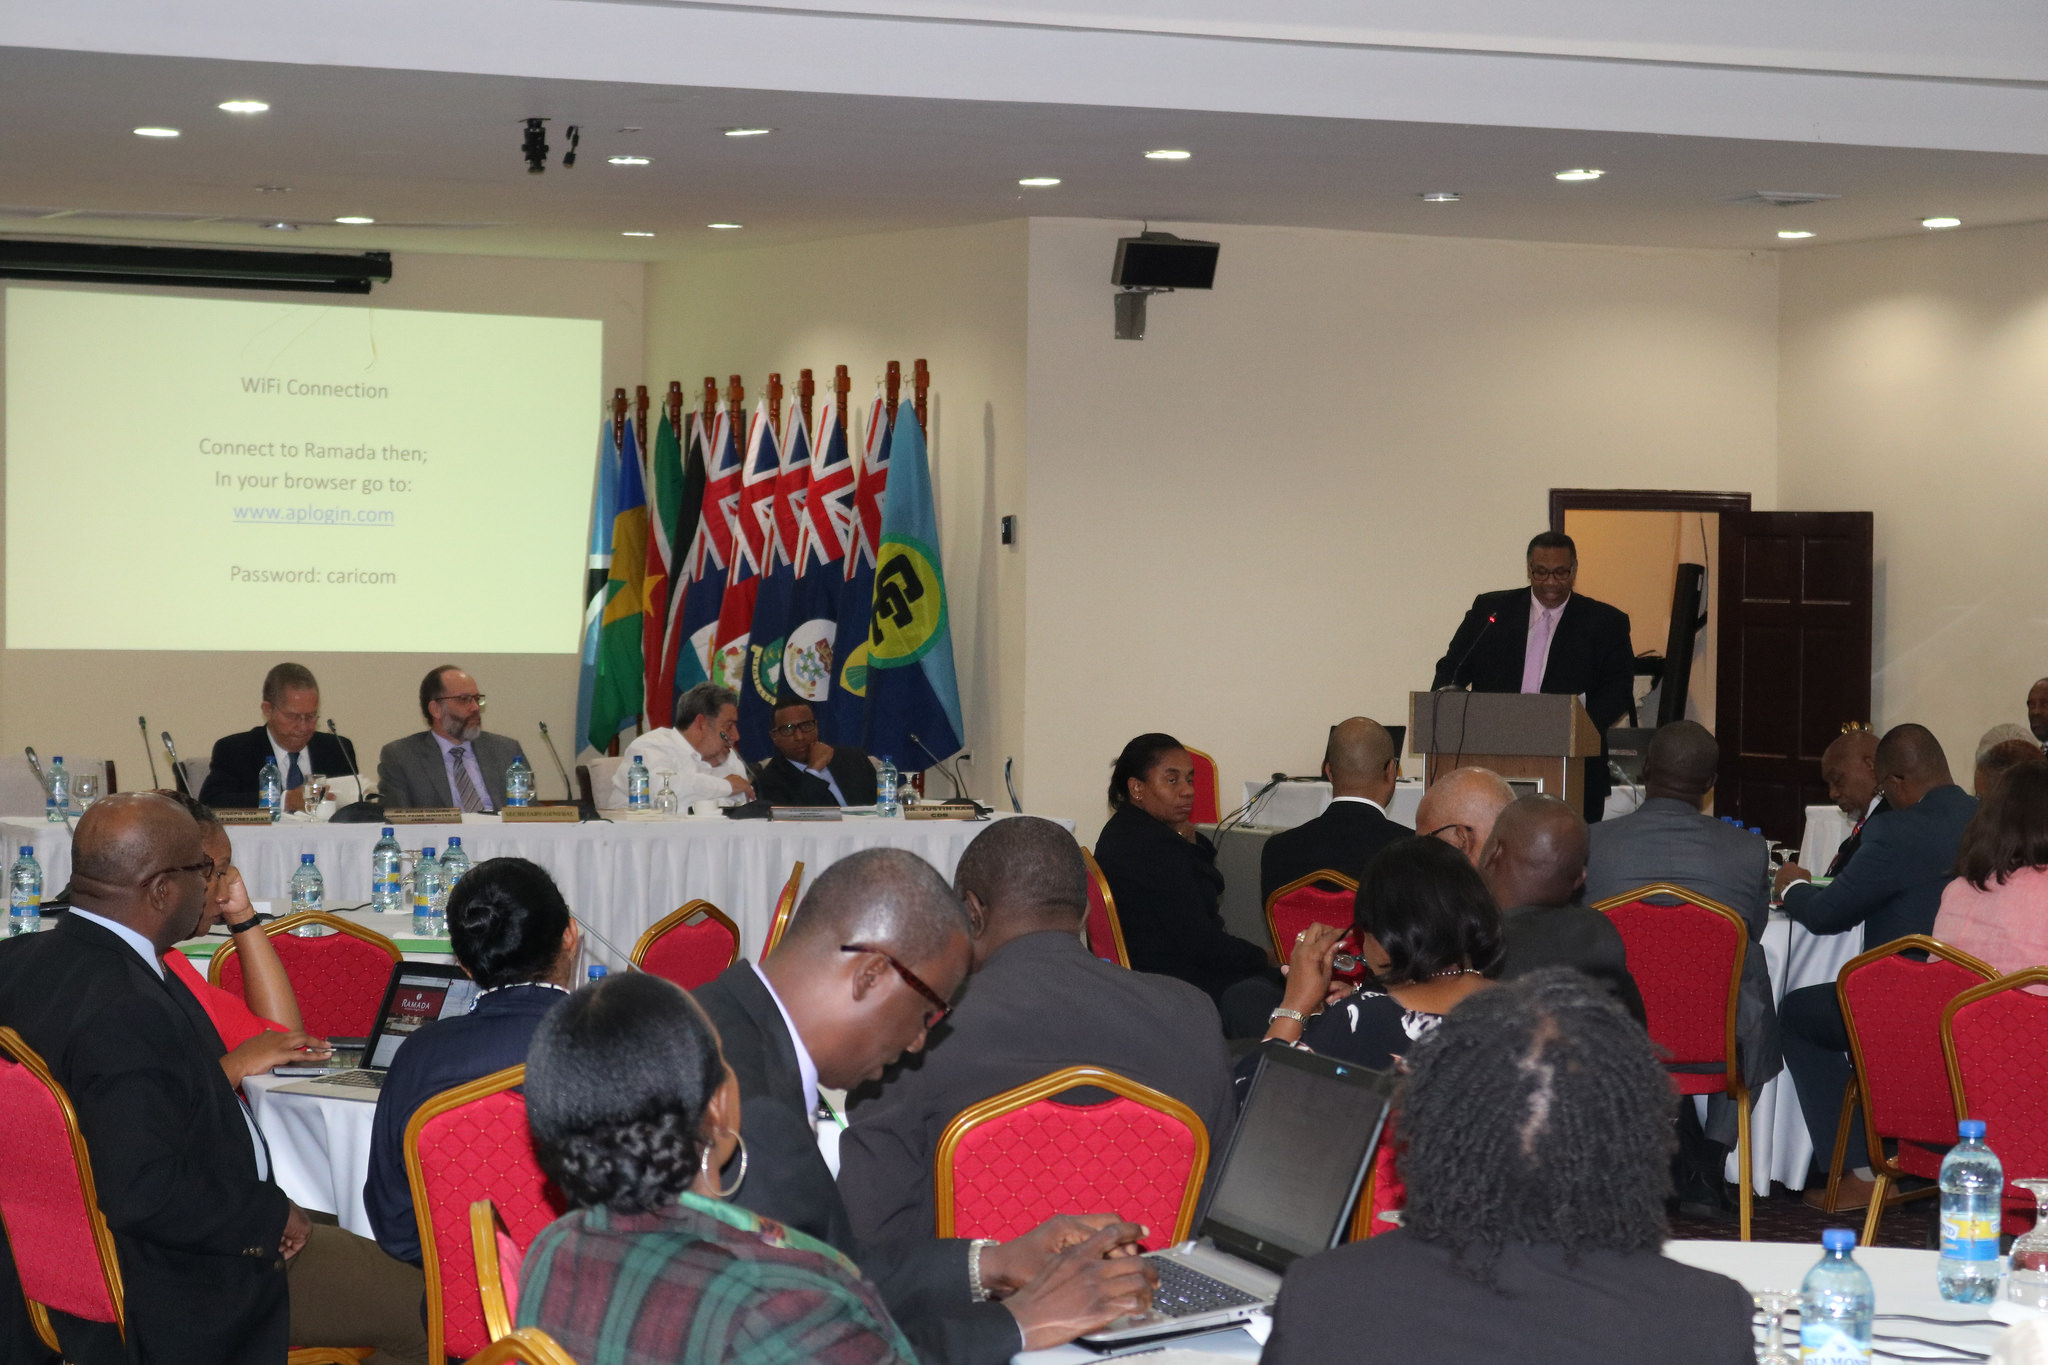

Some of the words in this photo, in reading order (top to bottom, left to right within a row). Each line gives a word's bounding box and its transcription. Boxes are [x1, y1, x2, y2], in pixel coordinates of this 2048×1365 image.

[241, 376, 281, 395] WiFi
[286, 378, 389, 399] Connection
[198, 437, 275, 457] Connect
[279, 442, 299, 458] to
[304, 441, 377, 462] Ramada
[381, 443, 428, 465] then;
[215, 470, 232, 487] In
[237, 475, 279, 492] your
[284, 471, 358, 492] browser
[361, 478, 384, 496] go
[388, 477, 412, 493] to:
[233, 502, 395, 527] www.aplogin.com
[230, 565, 321, 584] Password:
[326, 567, 397, 585] caricom
[401, 998, 430, 1009] RAMADA
